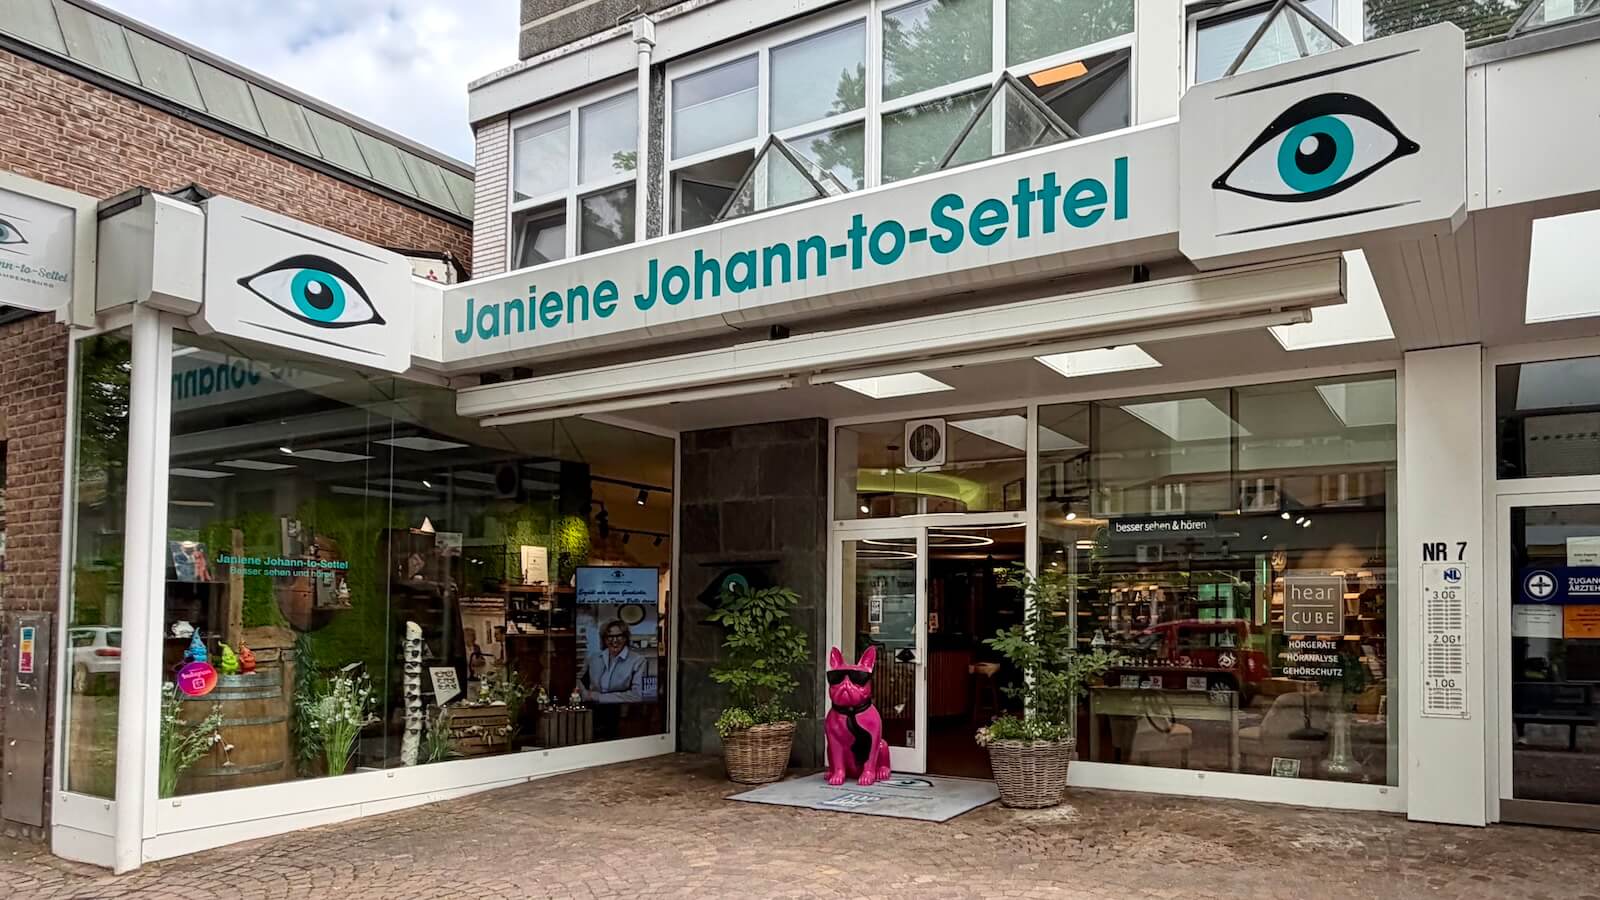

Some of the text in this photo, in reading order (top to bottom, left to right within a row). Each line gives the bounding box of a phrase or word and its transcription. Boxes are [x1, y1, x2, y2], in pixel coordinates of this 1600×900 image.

[455, 158, 1129, 344] Janiene Johann-to-Settel
[1116, 519, 1207, 533] besser sehen & hören
[1423, 541, 1468, 562] NR 7
[216, 553, 349, 570] Janiene Johann-to-Settel
[293, 568, 309, 578] und
[1443, 570, 1462, 582] NL
[1568, 576, 1600, 585] ZUGAN
[1291, 583, 1335, 600] hear
[1291, 611, 1335, 625] CUBE
[1288, 640, 1337, 650] HÖRGERÄTE
[1286, 653, 1339, 663] HÖRANALYSE
[1282, 666, 1344, 677] GEHÖRSCHUTZ
